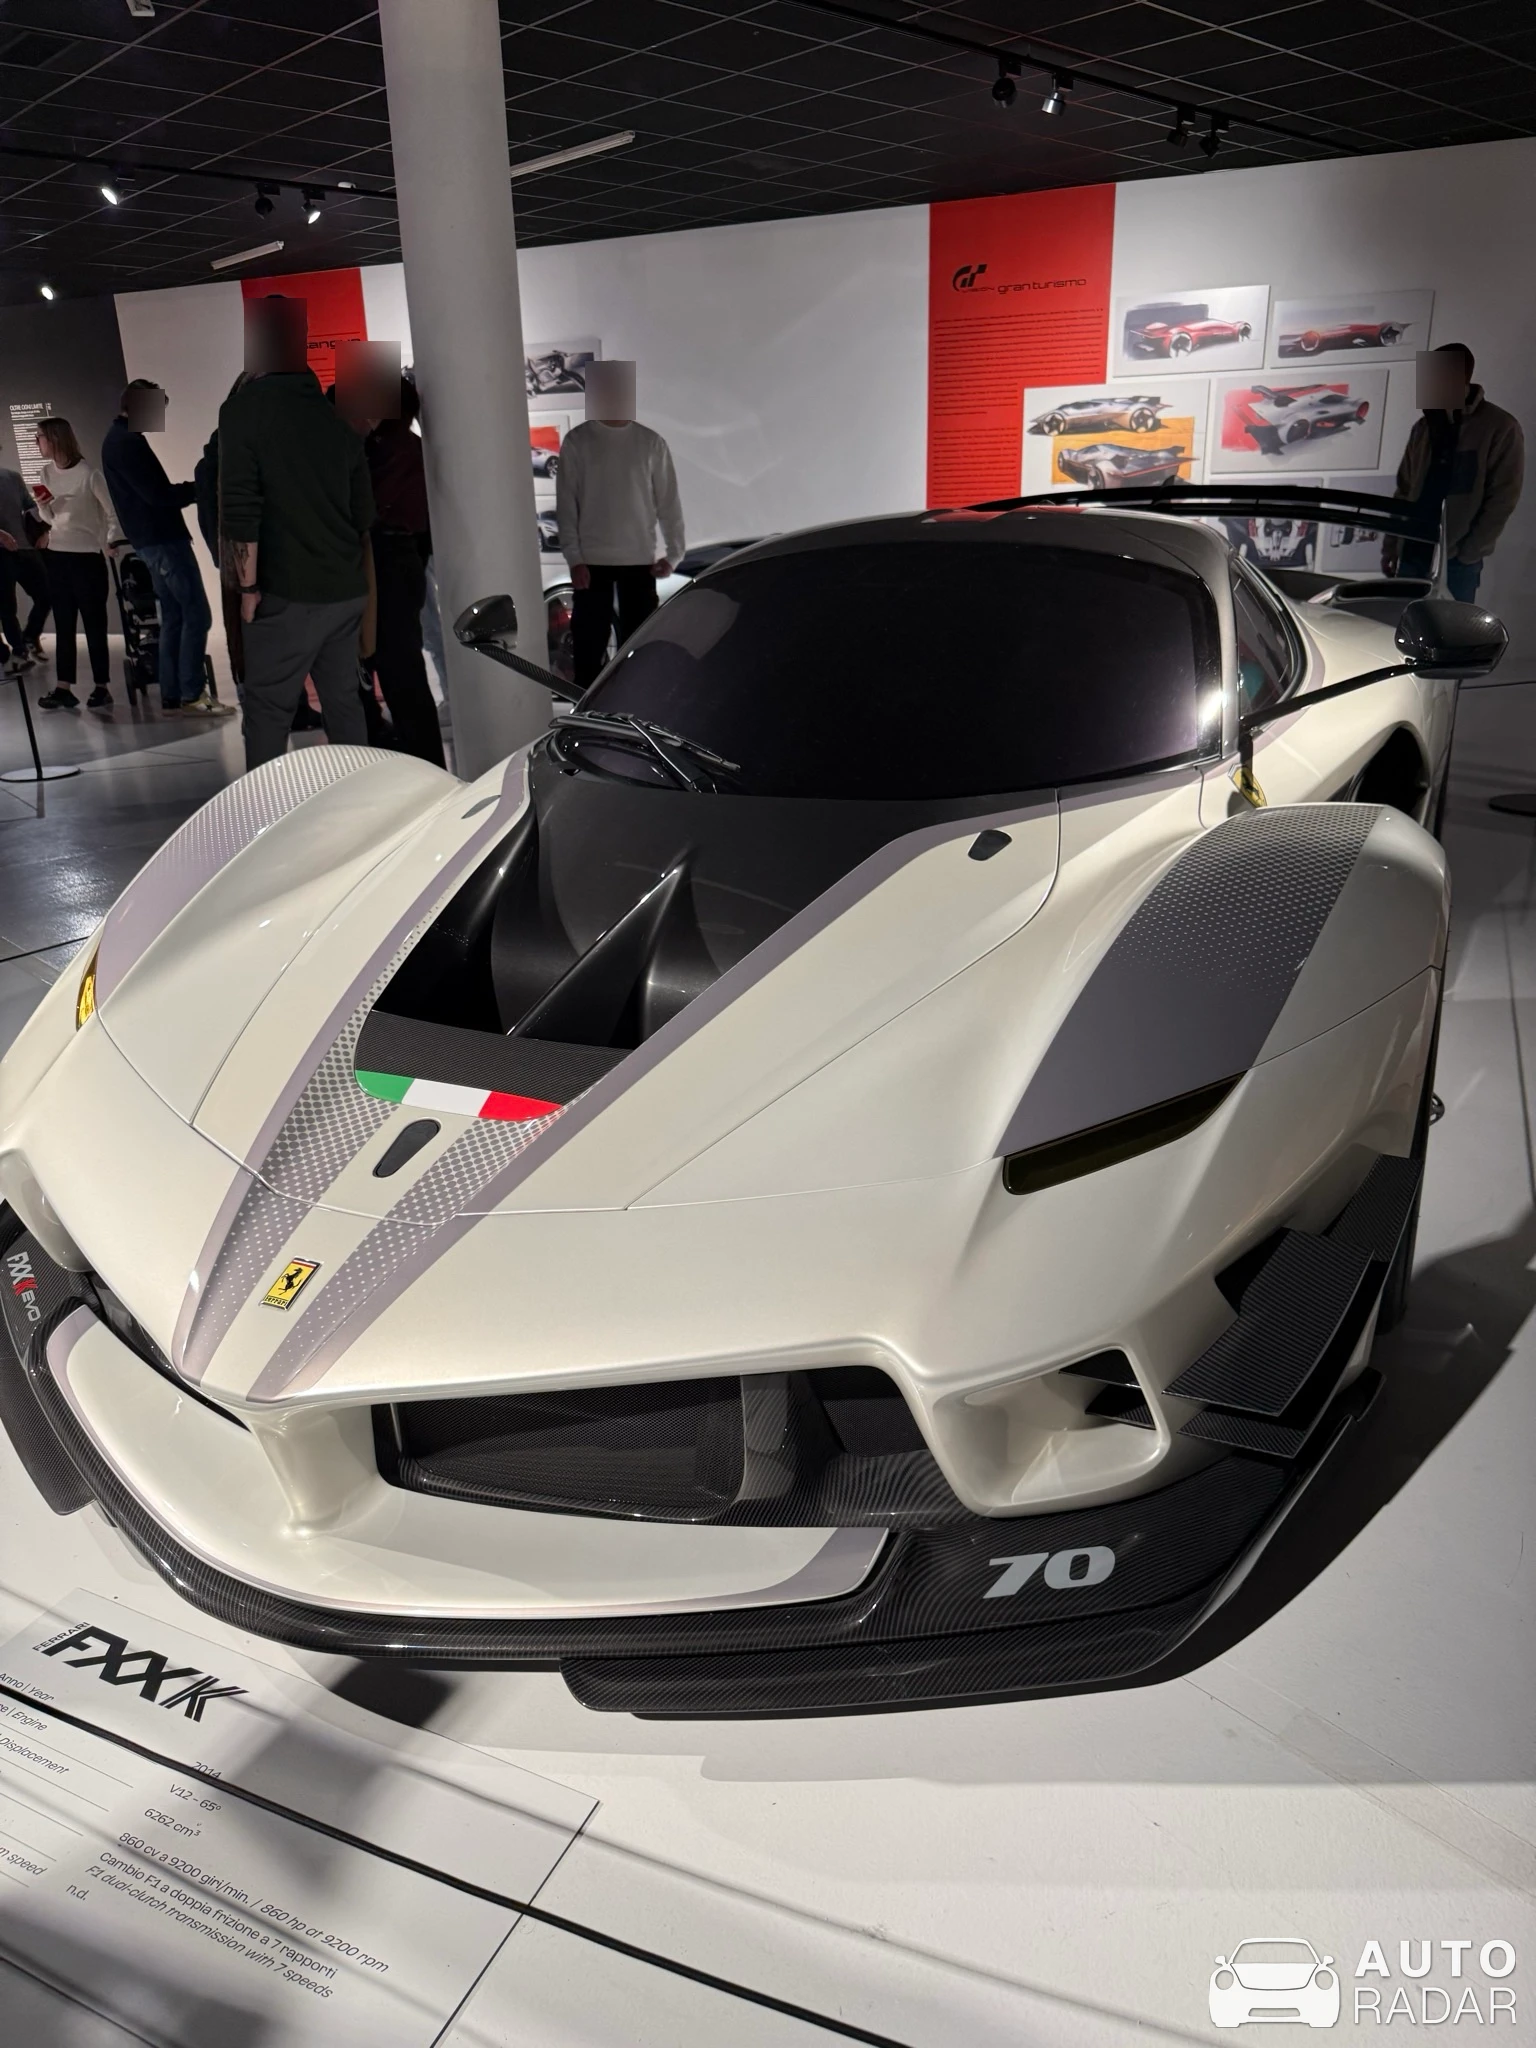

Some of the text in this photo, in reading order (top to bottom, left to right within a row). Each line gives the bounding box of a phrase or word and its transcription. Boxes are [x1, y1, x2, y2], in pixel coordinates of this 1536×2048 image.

[998, 283, 1030, 294] gran
[1032, 279, 1087, 290] turismo
[21, 1289, 41, 1322] EVO
[982, 1545, 1116, 1600] 70
[32, 1621, 90, 1652] FERRARI
[0, 1673, 24, 1689] Anno
[28, 1686, 54, 1701] Year
[11, 1711, 48, 1731] Engine
[0, 1737, 69, 1774] Displacement
[191, 1761, 222, 1779] 2014
[169, 1784, 193, 1801] V12
[144, 1807, 175, 1827] 6262
[6, 1853, 48, 1876] speed
[65, 1884, 89, 1901] n.d.
[119, 1832, 145, 1849] 860
[143, 1845, 161, 1857] cv
[158, 1853, 169, 1863] a
[168, 1856, 202, 1878] 9200
[260, 1904, 290, 1921] 860
[286, 1917, 306, 1931] hp
[305, 1928, 323, 1939] at
[321, 1934, 359, 1957] 9200
[356, 1953, 389, 1973] rpm
[100, 1852, 338, 1979] Cambio F1 a doppia frizione a 7 rapporti
[84, 1865, 334, 1998] F1 dual-clutch transmission with 7 speeds
